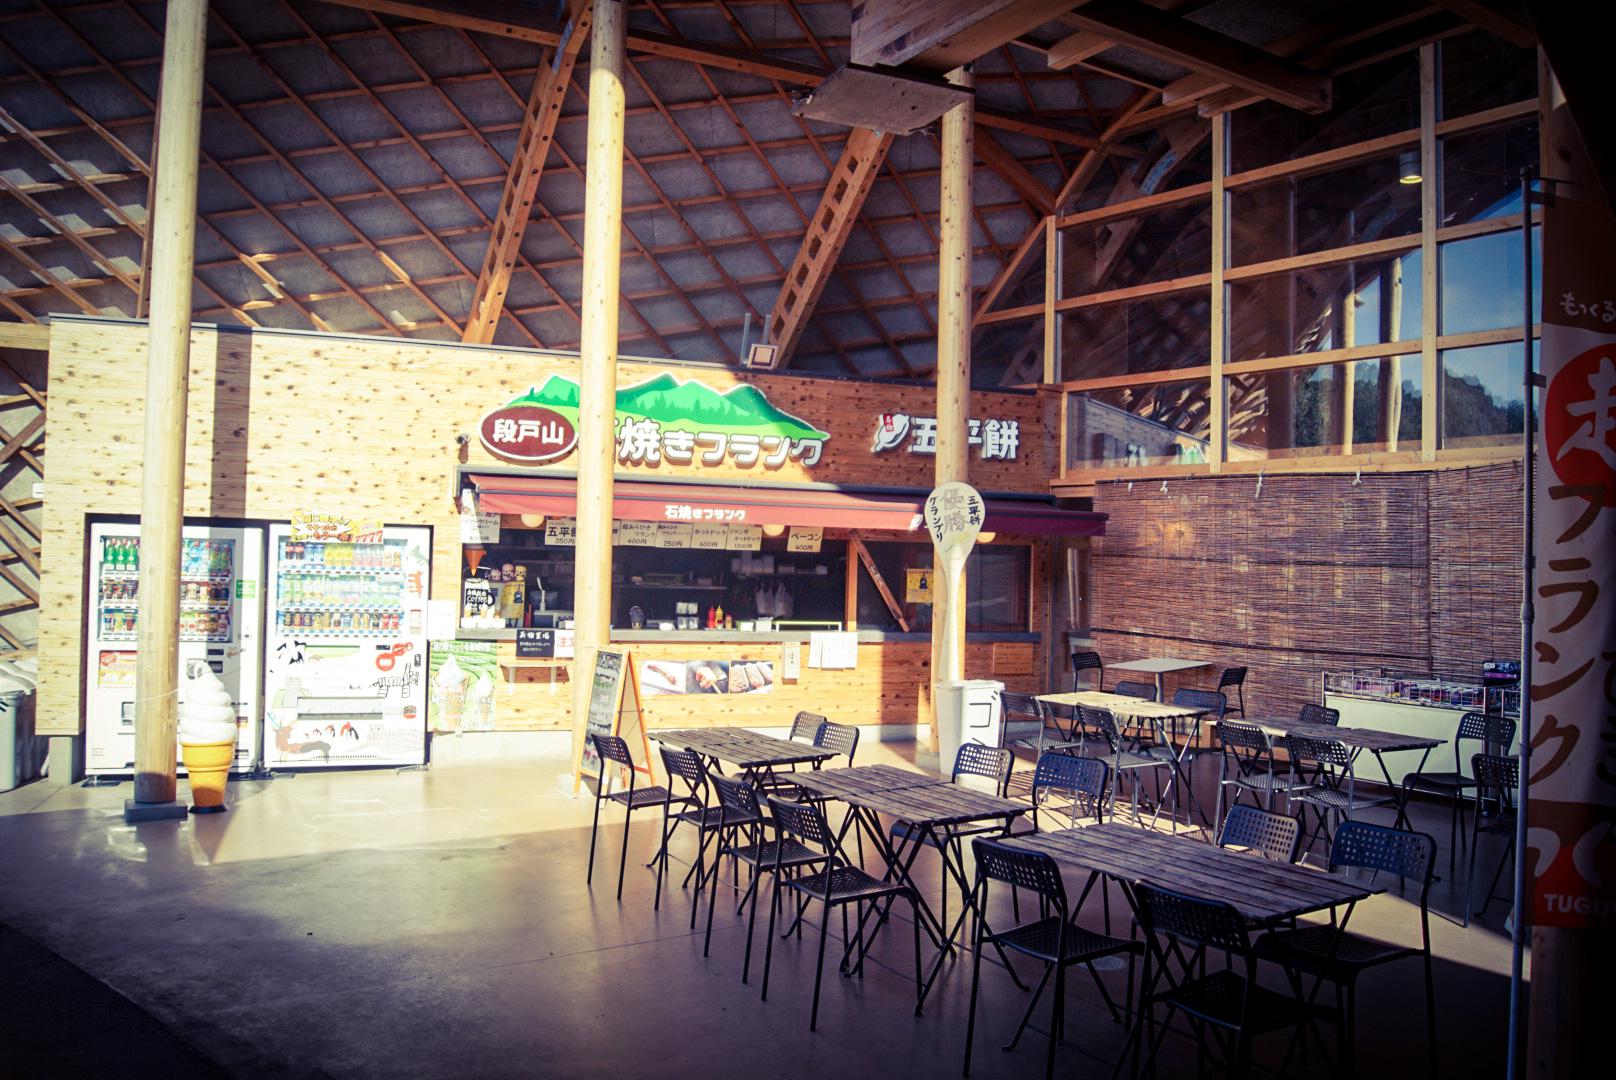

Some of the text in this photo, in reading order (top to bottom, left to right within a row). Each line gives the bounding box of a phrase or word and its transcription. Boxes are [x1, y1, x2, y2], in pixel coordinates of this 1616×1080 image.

[492, 418, 564, 445] 段戸山
[613, 416, 823, 466] 焼きフランク
[665, 504, 747, 521] 石焼きフランク
[929, 496, 944, 542] グランプリ
[941, 488, 967, 534] 優勝
[967, 496, 982, 526] 五平餅
[791, 532, 822, 541] ベーコン
